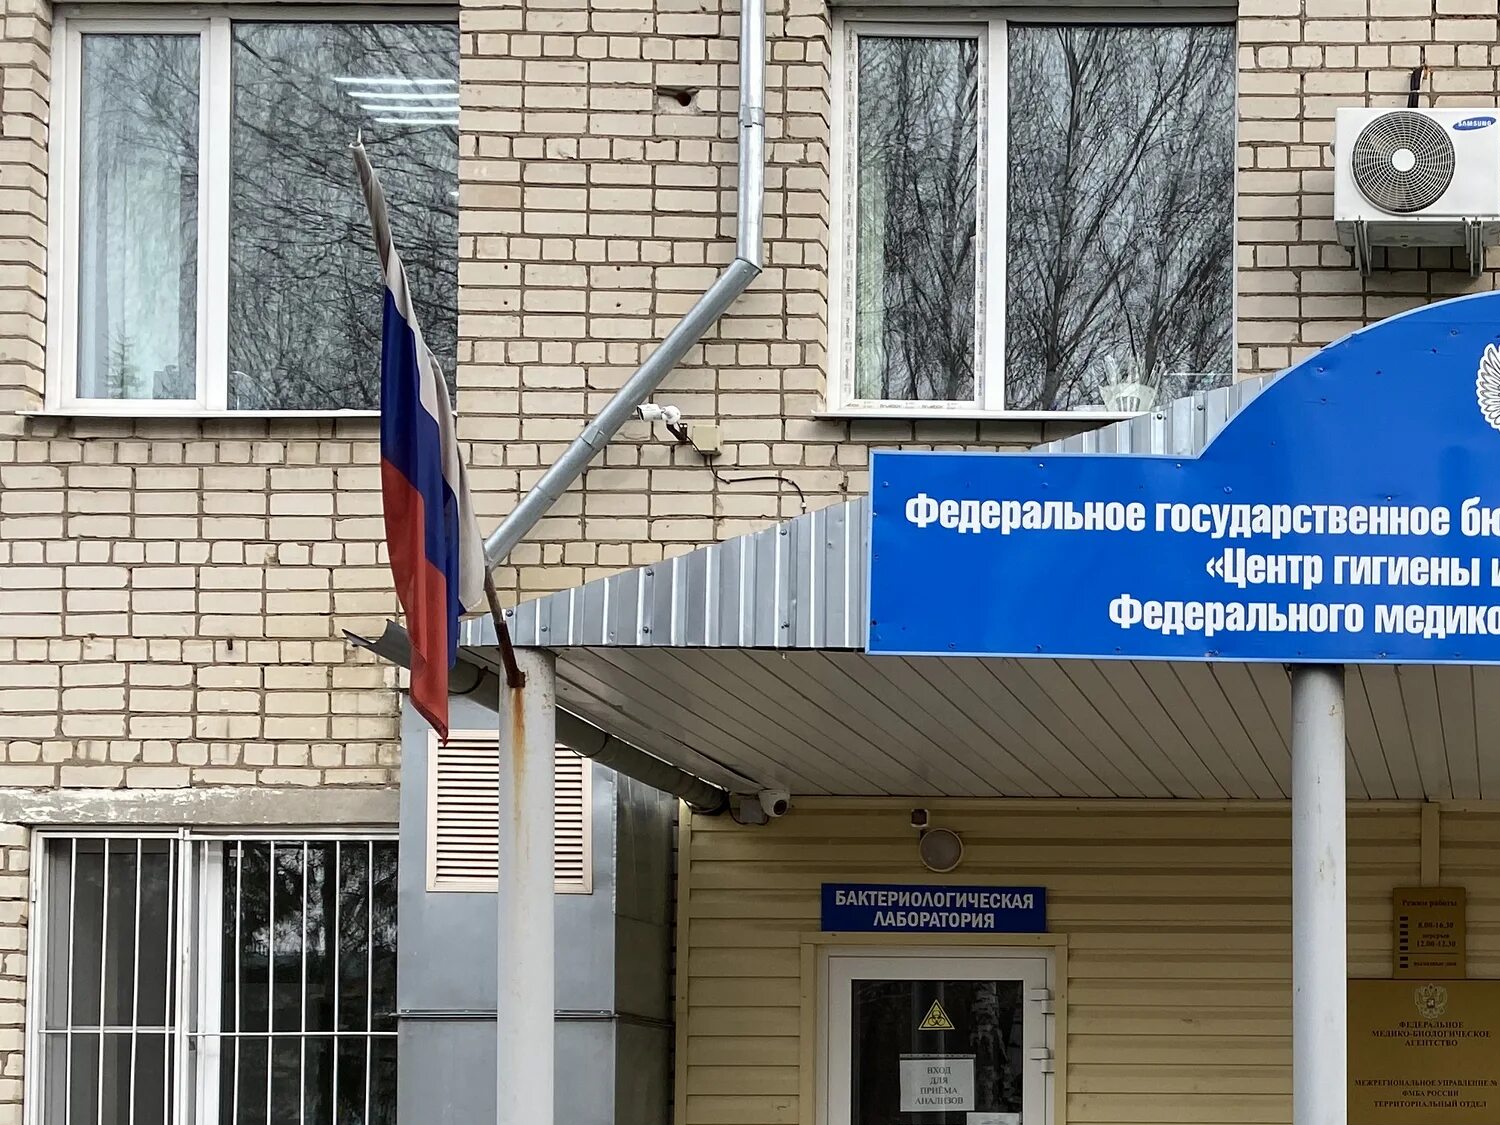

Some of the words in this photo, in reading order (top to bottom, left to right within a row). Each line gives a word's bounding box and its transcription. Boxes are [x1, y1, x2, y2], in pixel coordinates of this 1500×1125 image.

[906, 494, 1145, 534] Федеральное
[1156, 501, 1450, 539] государственное
[1207, 548, 1322, 589] «Центр
[1334, 556, 1480, 586] гигиены
[1109, 594, 1363, 636] Федерального
[835, 890, 1034, 909] БАКТЕРИОЛОГИЧЕСКАЯ
[873, 912, 995, 929] ЛАБОРАТОРИЯ
[1399, 1021, 1463, 1029] ФЕДЕРАЛЬНОЕ
[930, 1077, 948, 1085] ДЛЯ
